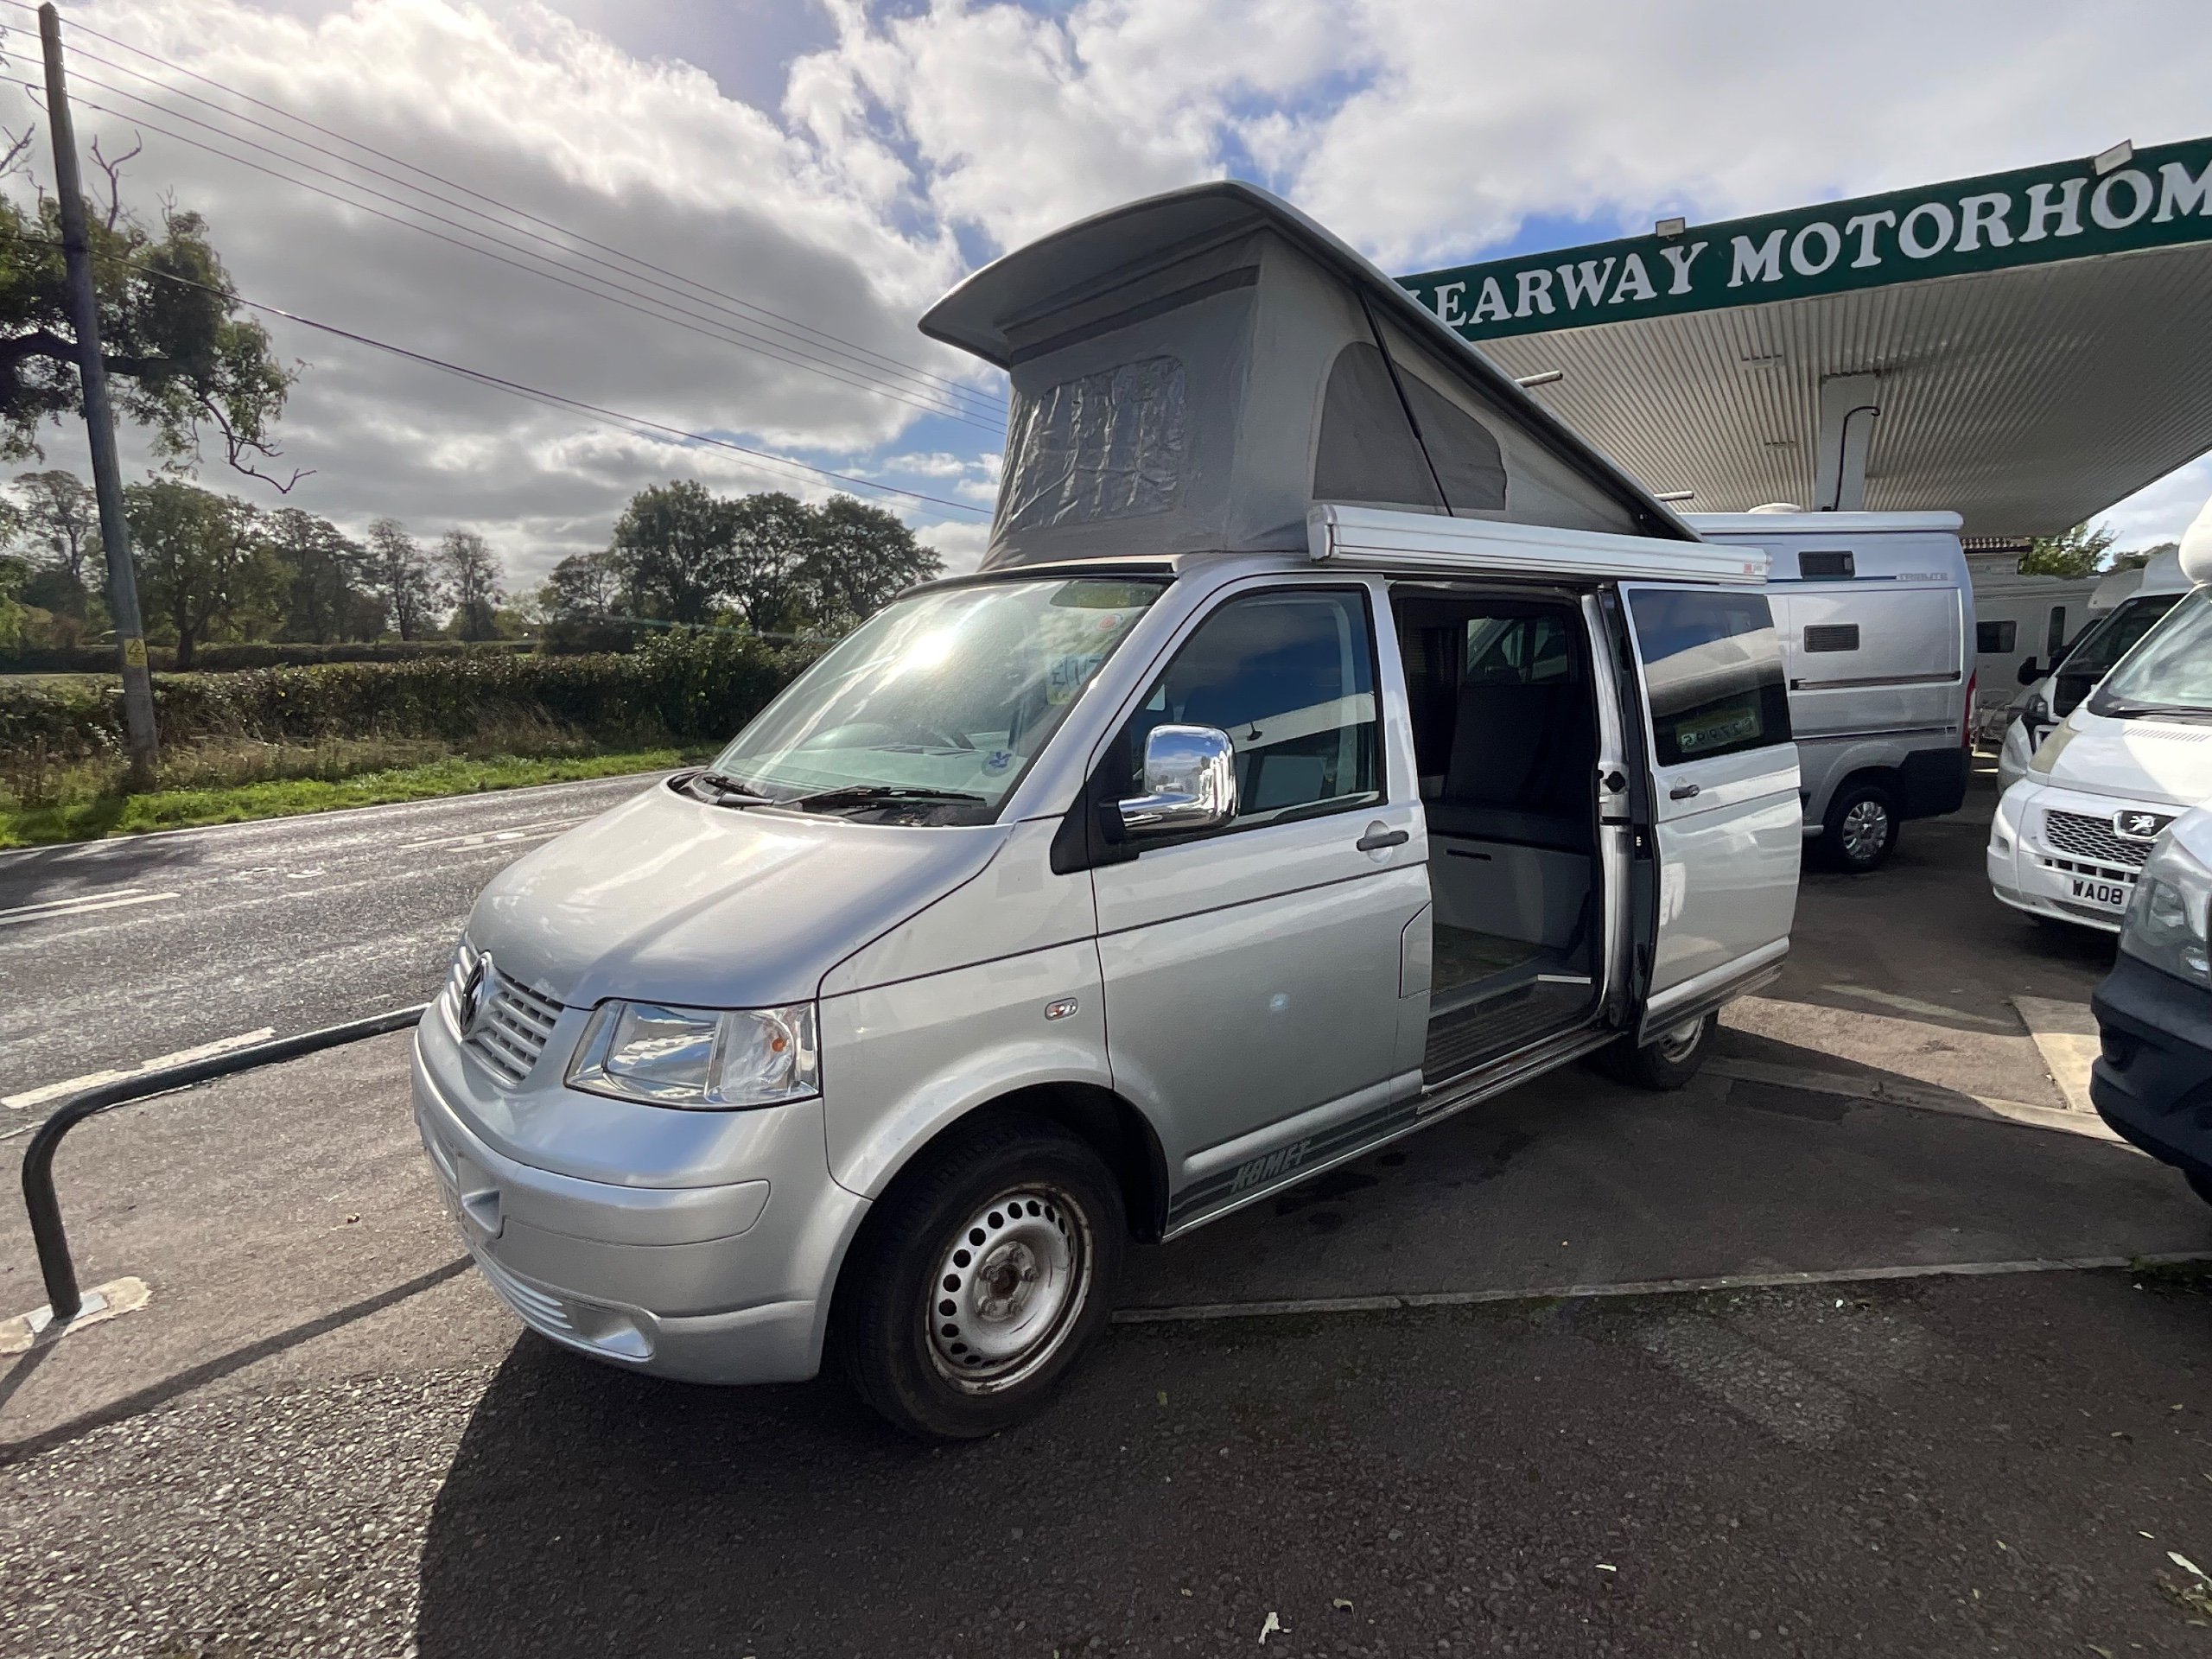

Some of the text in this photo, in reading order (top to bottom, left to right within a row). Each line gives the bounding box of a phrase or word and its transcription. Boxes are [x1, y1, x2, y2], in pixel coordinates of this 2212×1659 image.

[1407, 159, 2212, 327] EARWAY MOTORHOM
[2073, 880, 2123, 905] WA08
